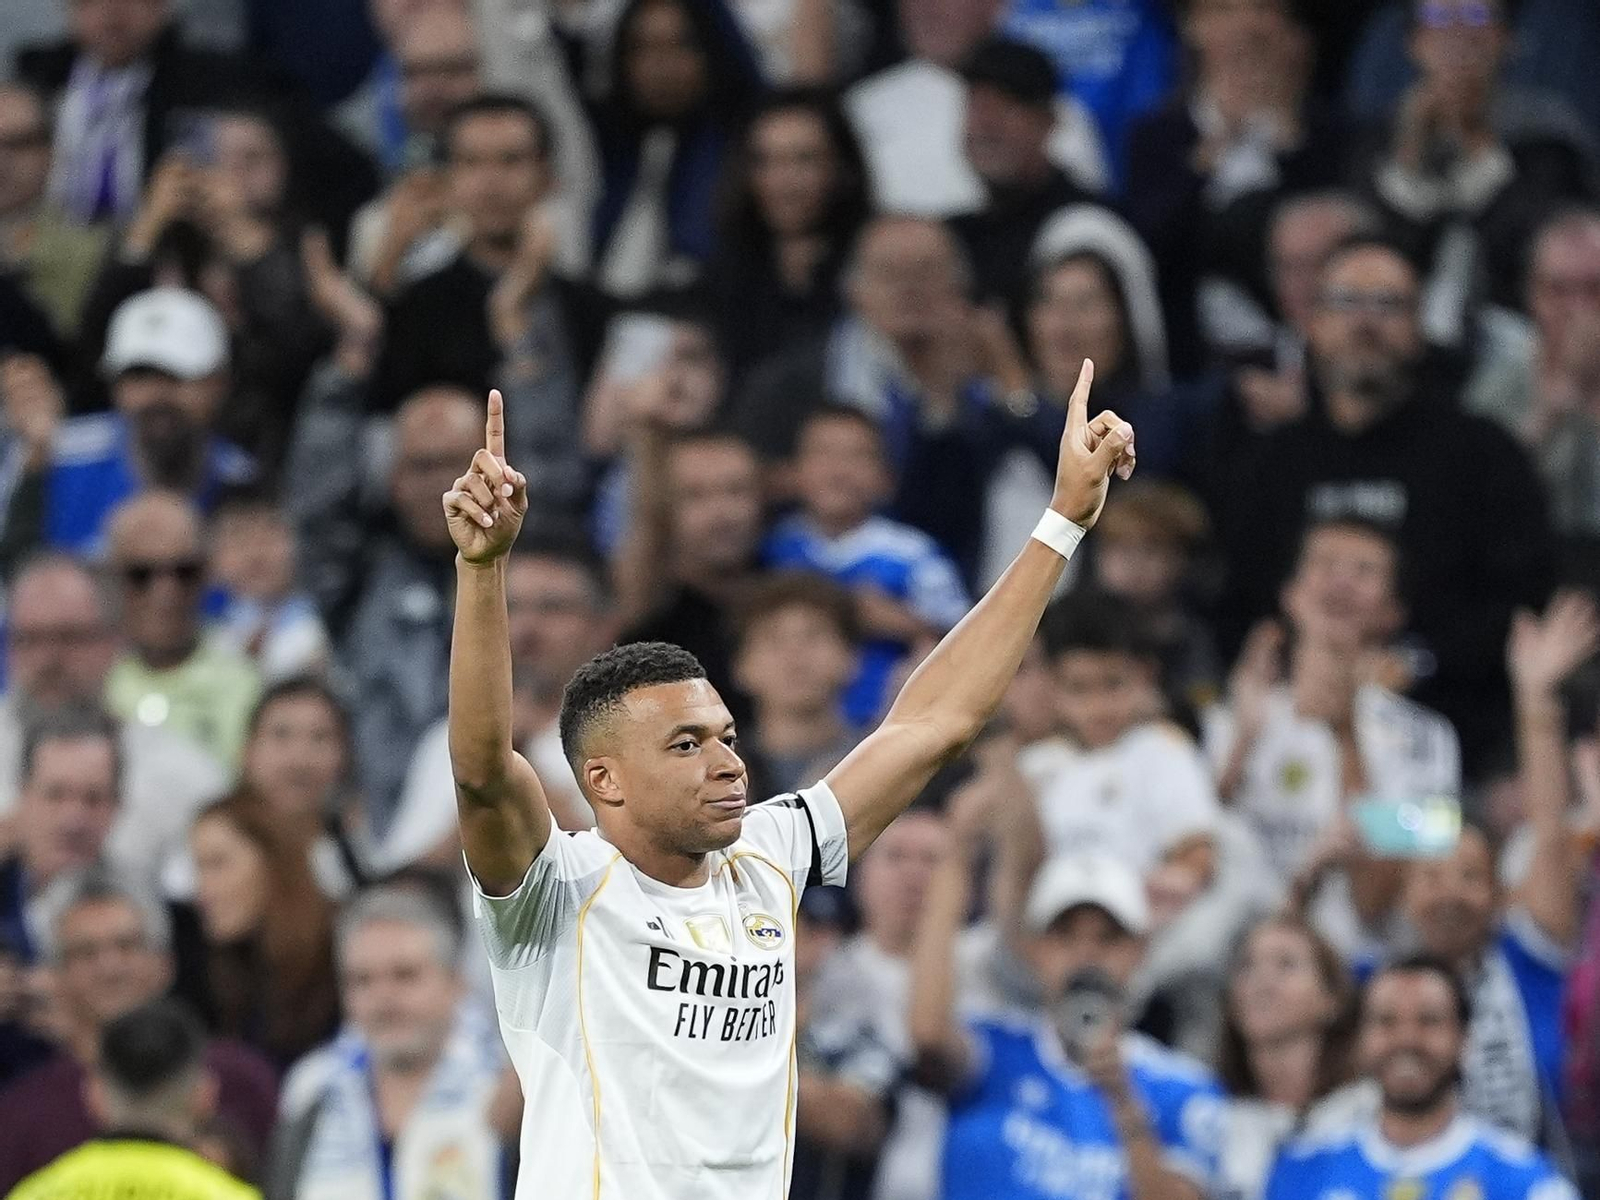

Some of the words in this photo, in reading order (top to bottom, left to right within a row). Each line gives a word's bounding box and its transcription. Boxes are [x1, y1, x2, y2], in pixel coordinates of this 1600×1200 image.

[647, 946, 784, 999] Emirat
[673, 1002, 715, 1040] FLY
[720, 1000, 777, 1042] BETER
